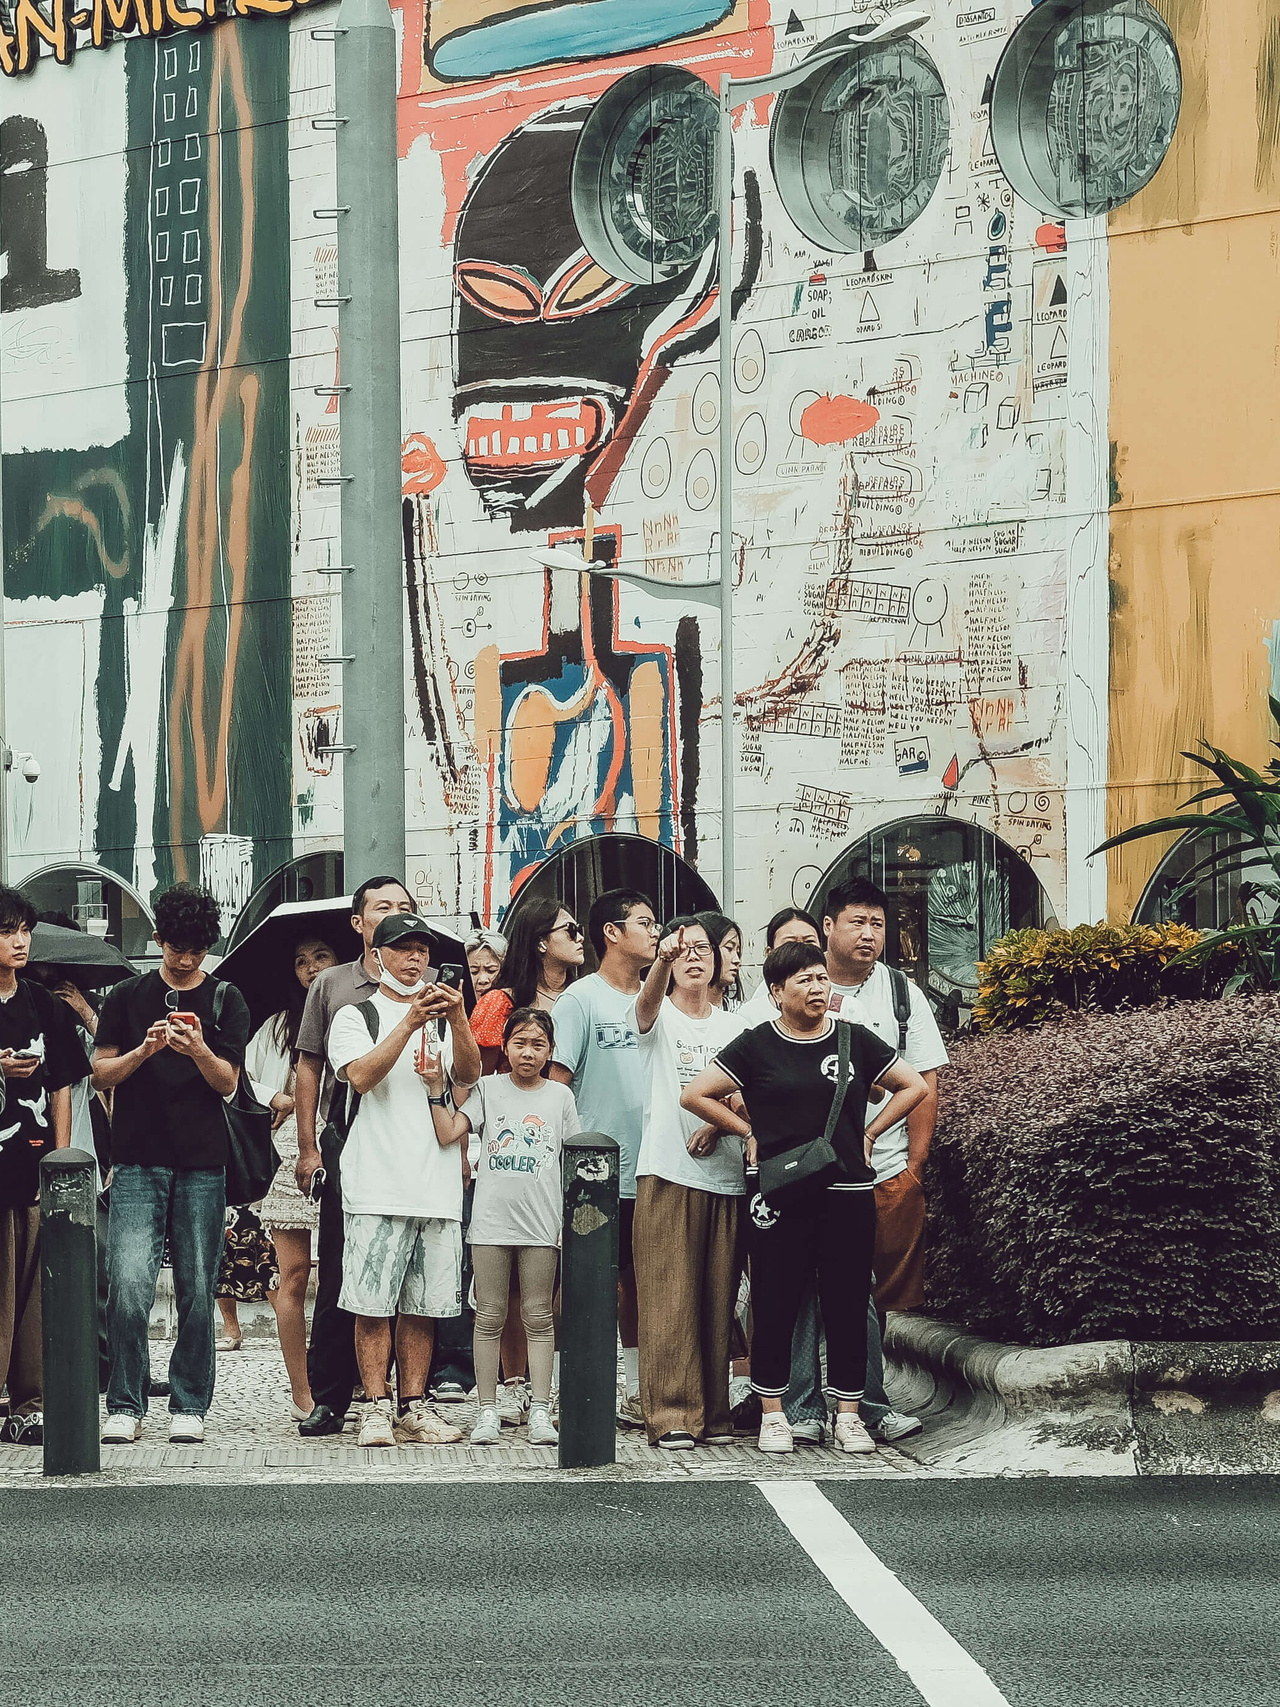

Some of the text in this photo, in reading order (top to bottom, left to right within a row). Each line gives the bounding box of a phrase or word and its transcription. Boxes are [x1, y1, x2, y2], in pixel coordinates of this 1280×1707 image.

[812, 307, 826, 319] OIL
[995, 537, 1016, 546] SUGAR
[742, 742, 762, 752] SUGAR
[741, 755, 761, 763] SUGAR
[972, 795, 991, 806] PINE
